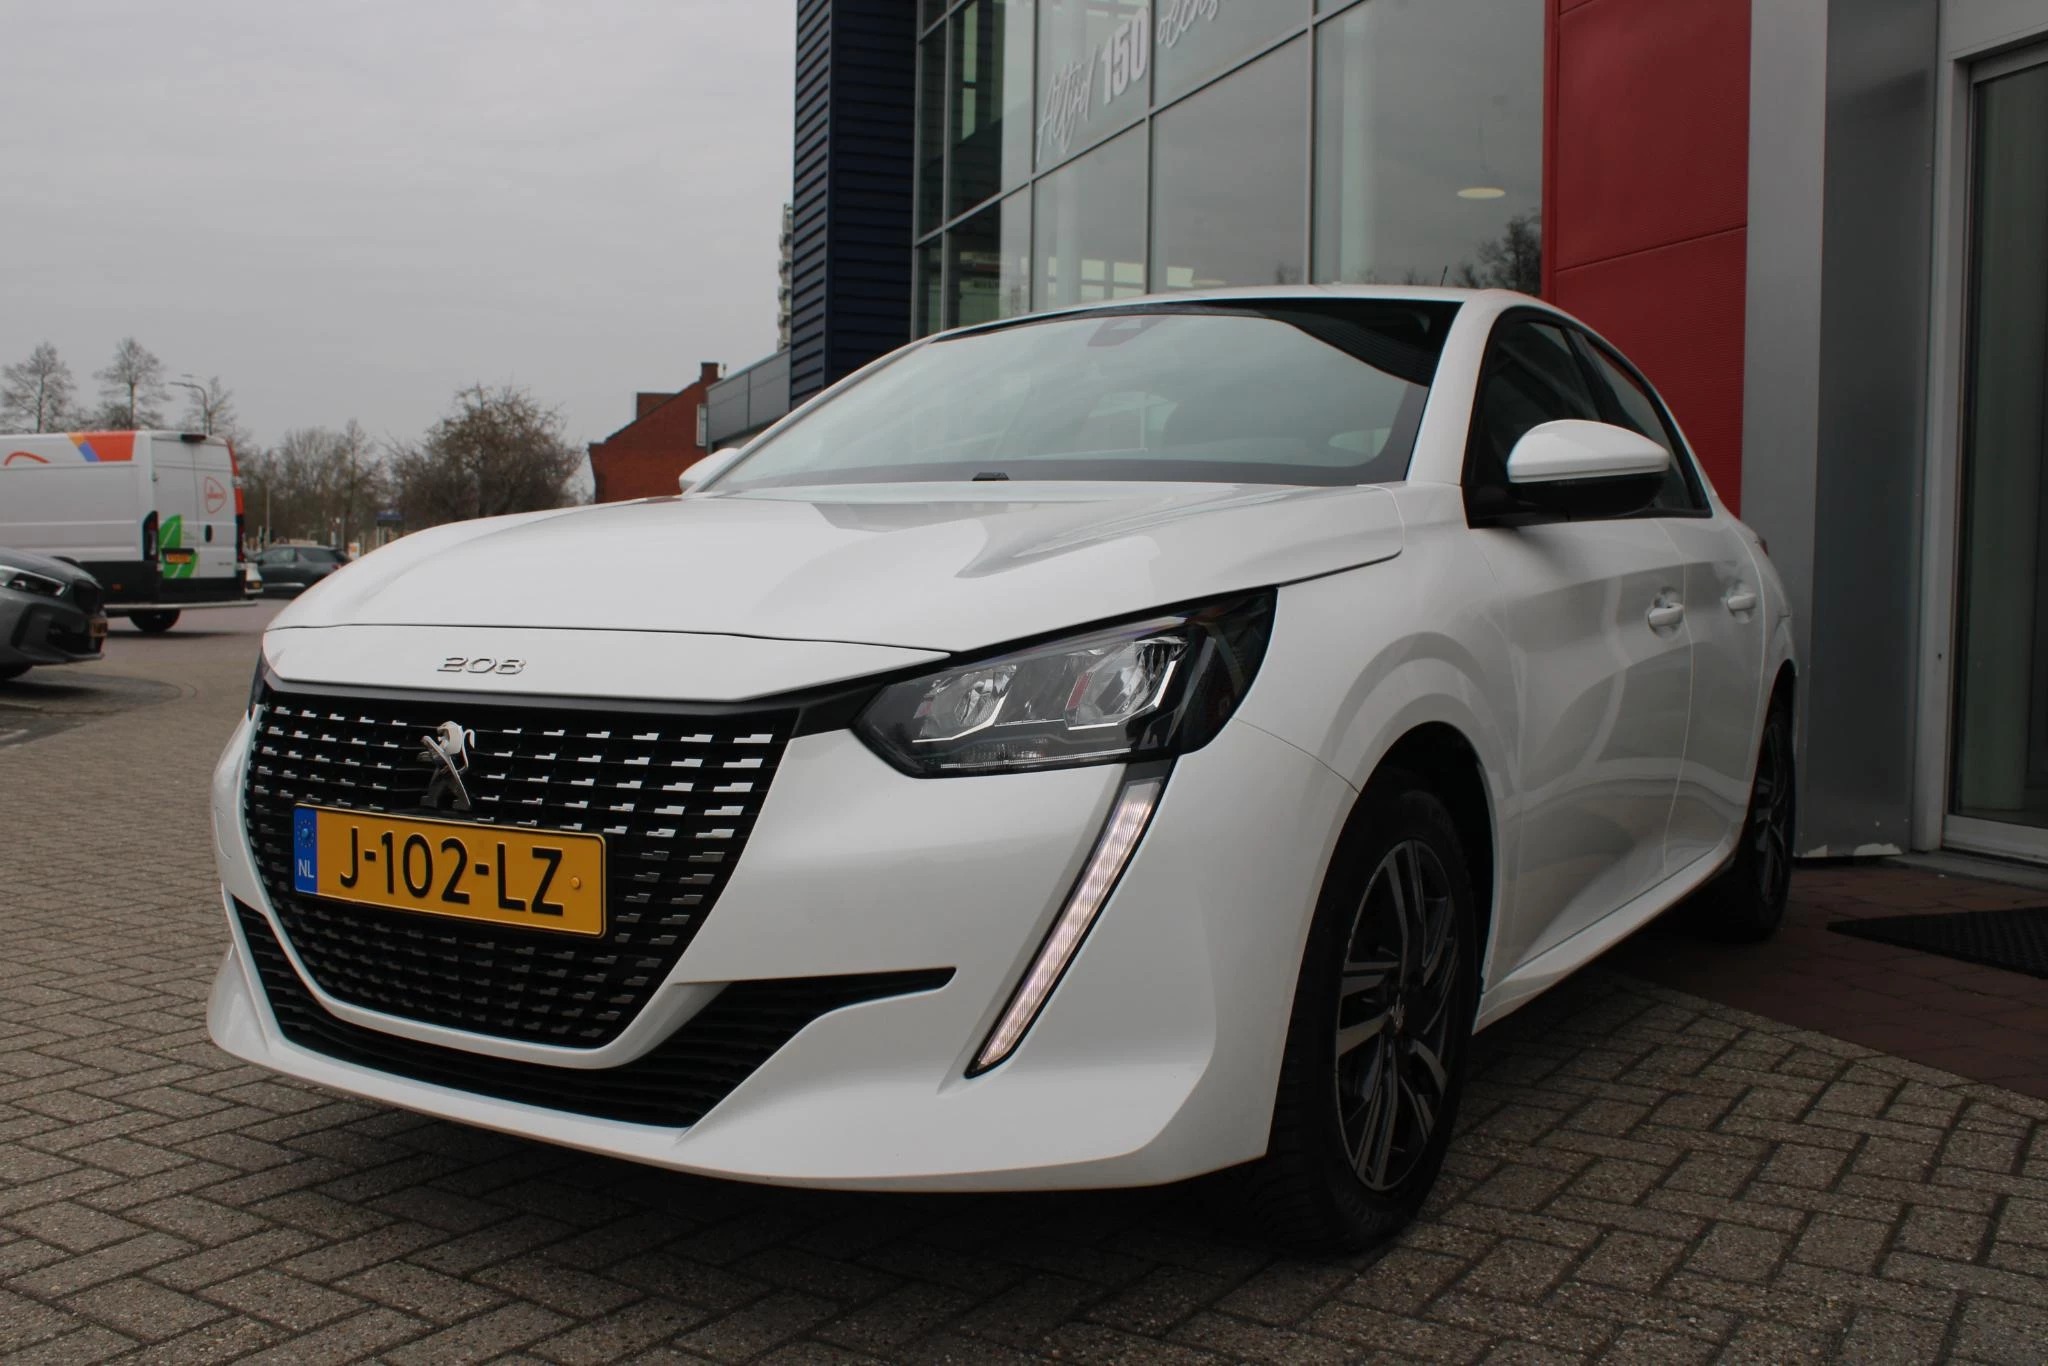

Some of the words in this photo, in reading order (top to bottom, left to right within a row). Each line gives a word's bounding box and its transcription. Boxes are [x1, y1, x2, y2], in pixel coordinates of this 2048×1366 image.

[1102, 6, 1148, 106] 150
[436, 656, 526, 676] 208
[298, 858, 315, 879] NL
[340, 826, 564, 916] J-102-LZ
